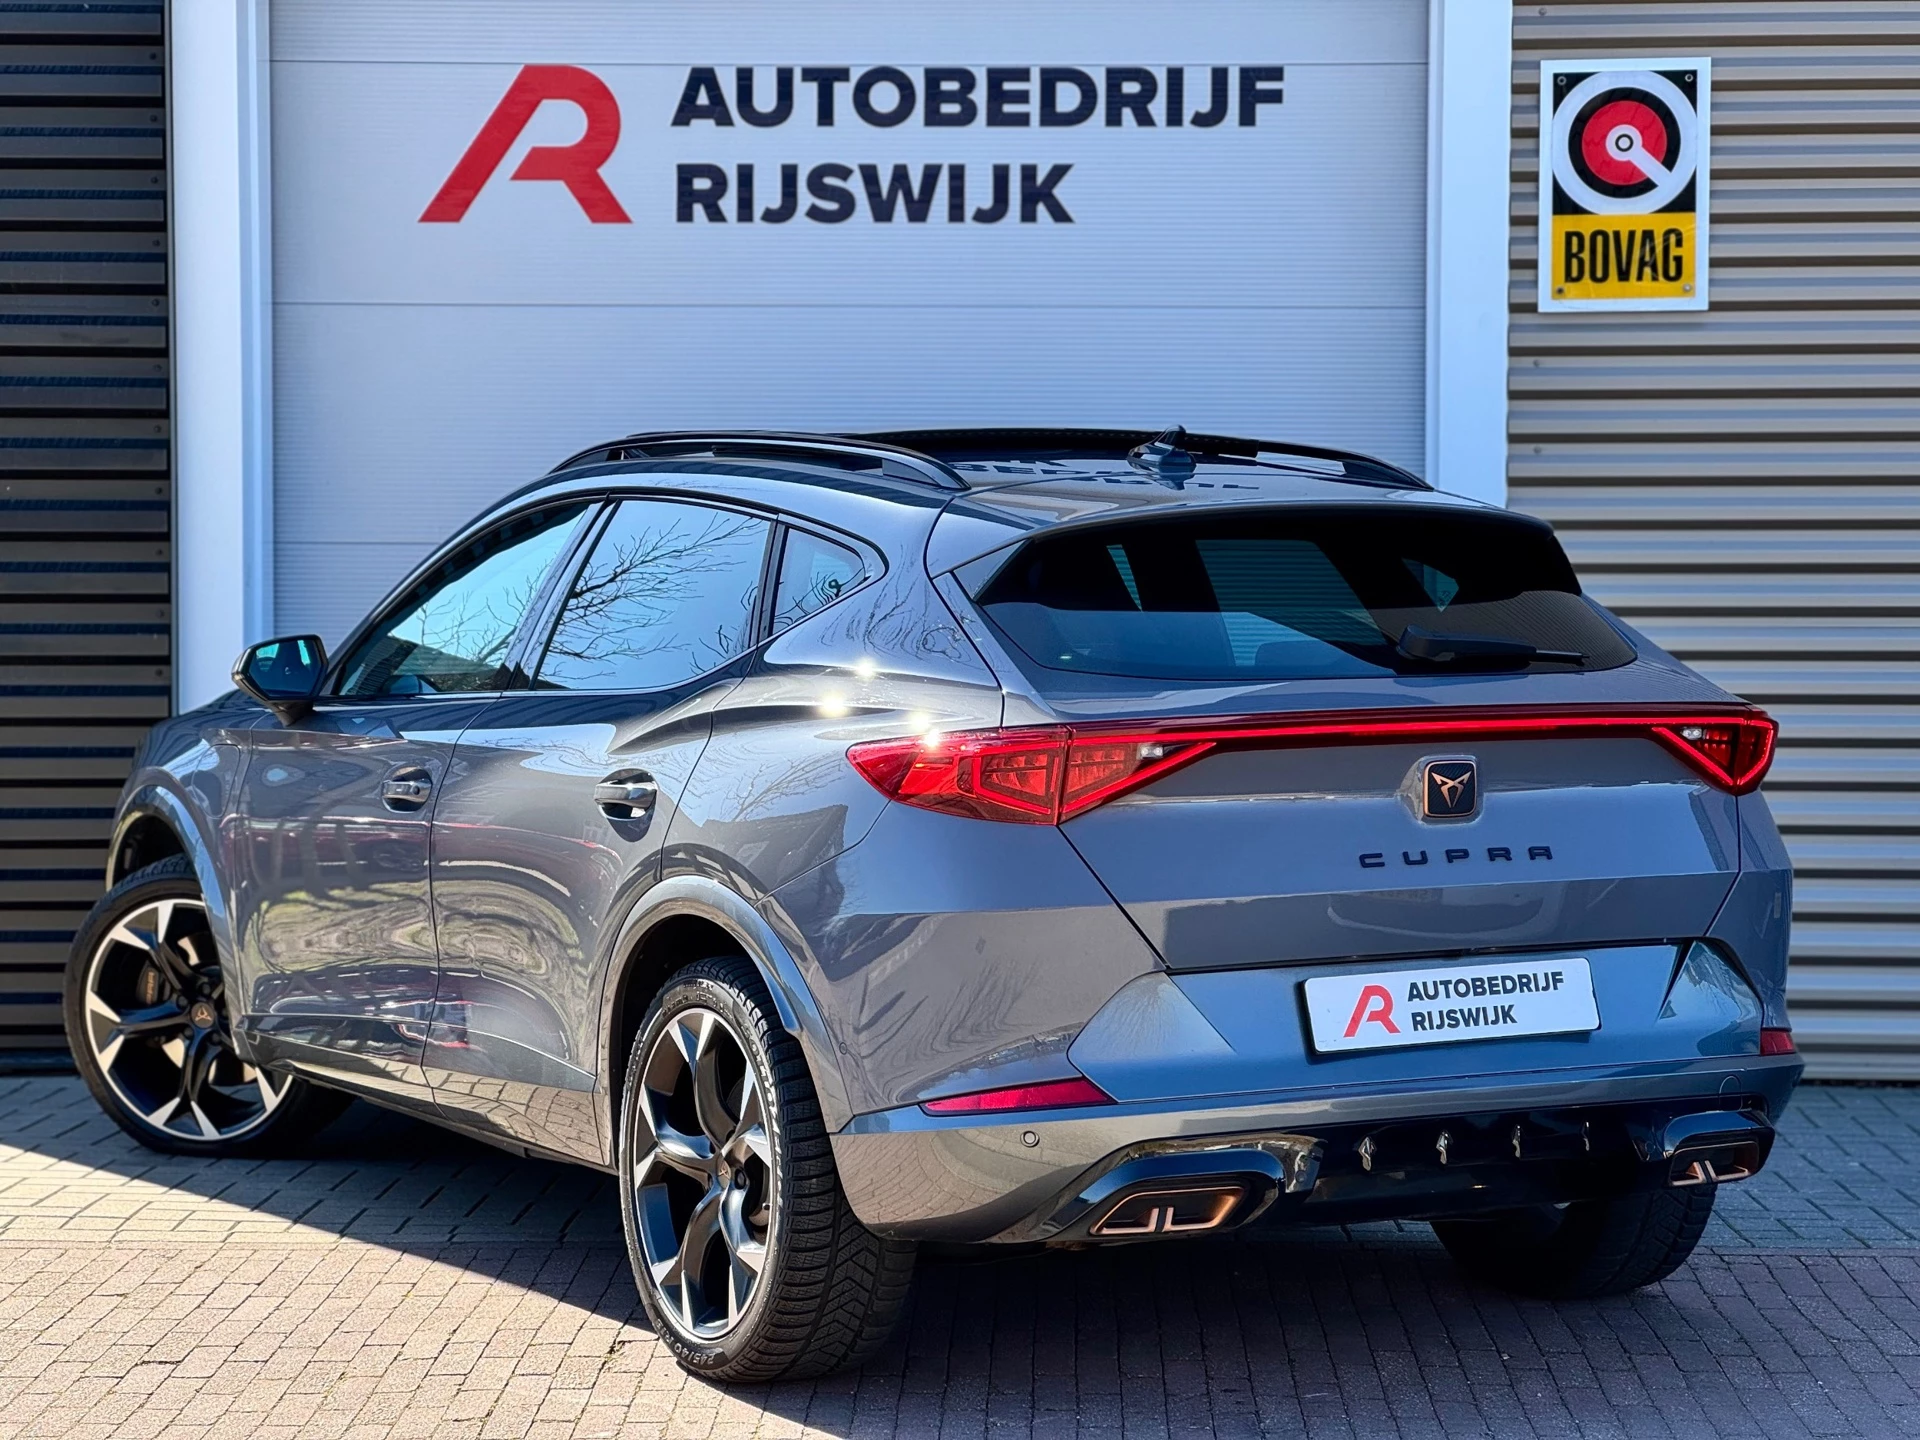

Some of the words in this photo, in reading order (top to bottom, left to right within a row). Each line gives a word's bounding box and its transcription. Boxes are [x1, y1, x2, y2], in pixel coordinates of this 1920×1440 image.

[671, 66, 1284, 128] AUTOBEDRIJF
[676, 163, 1075, 224] RIJSWIJK
[1564, 228, 1683, 283] BOVAG
[1359, 846, 1553, 868] CUPRA
[1408, 971, 1564, 1002] AUTOBEDRIJF
[1411, 1004, 1517, 1032] RIJSWIJK
